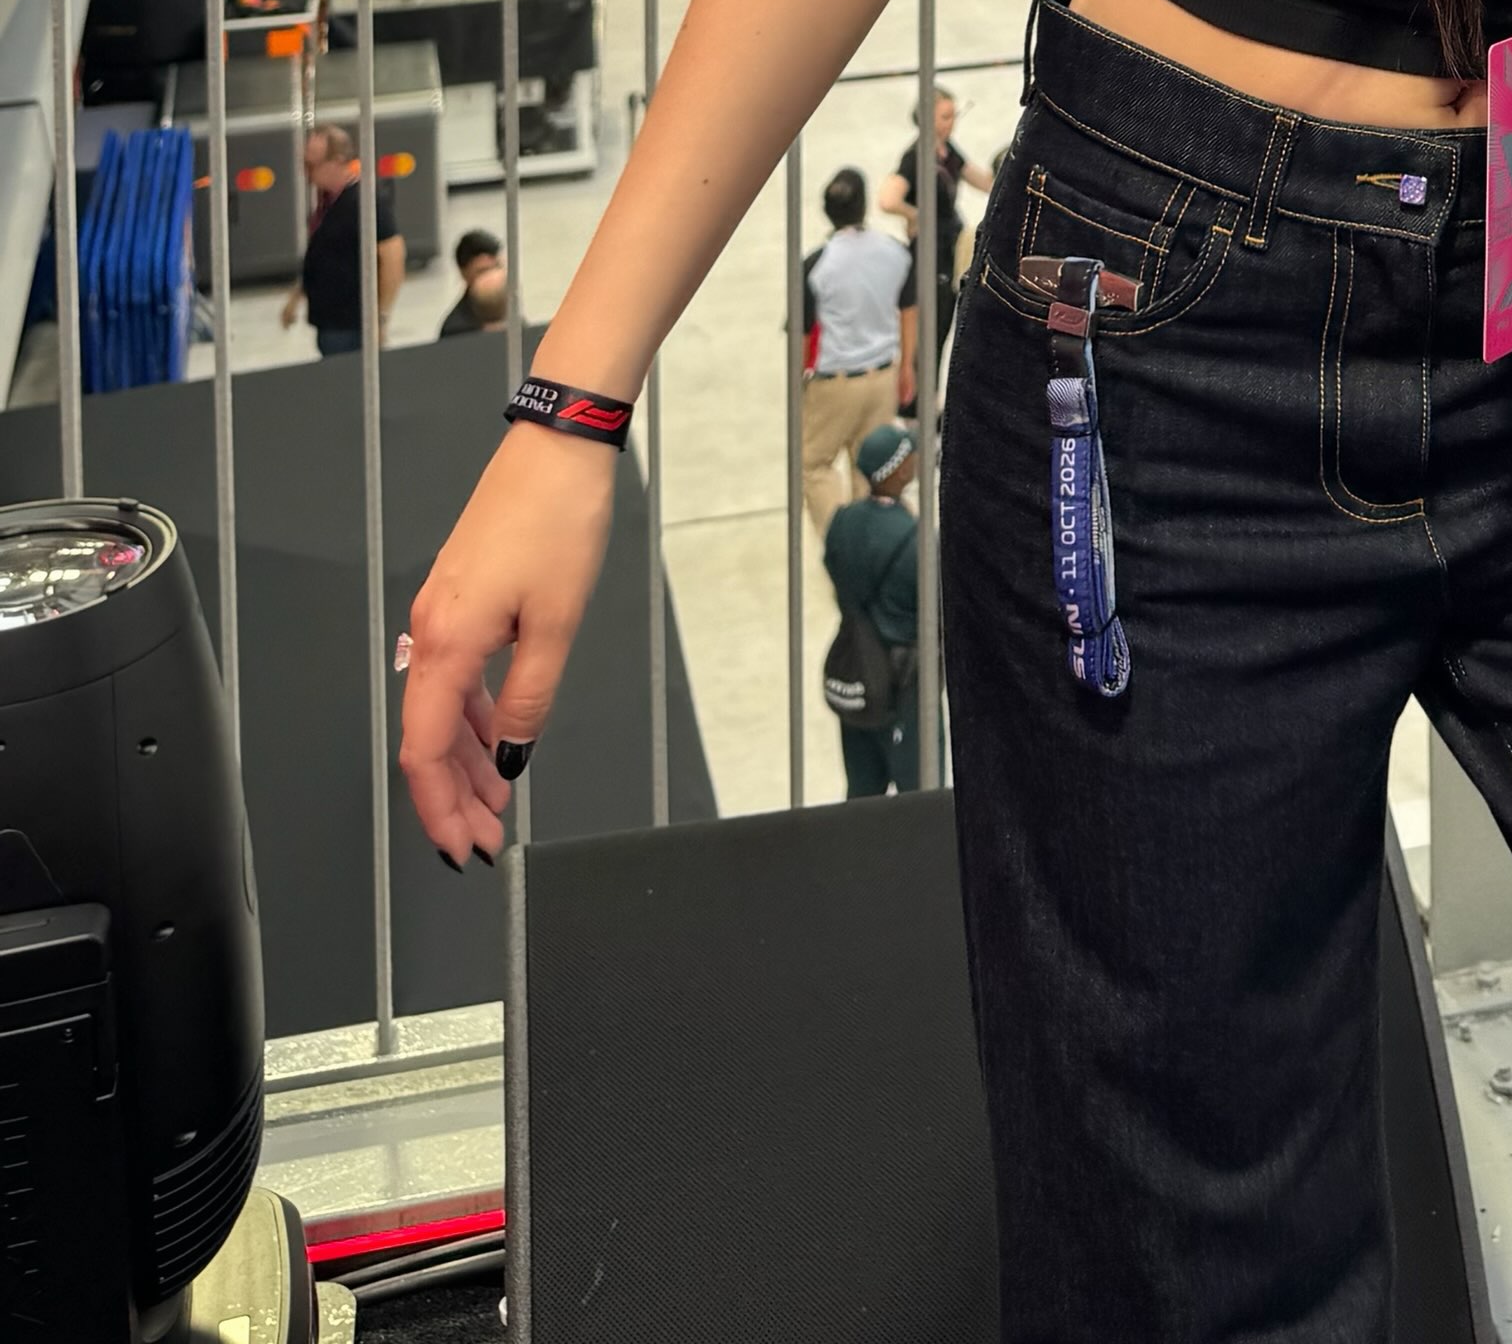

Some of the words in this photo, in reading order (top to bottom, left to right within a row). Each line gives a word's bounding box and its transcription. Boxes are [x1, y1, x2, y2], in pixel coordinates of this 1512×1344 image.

[1060, 437, 1077, 496] 2026
[1060, 502, 1077, 545] OCT
[1062, 551, 1077, 579] 11
